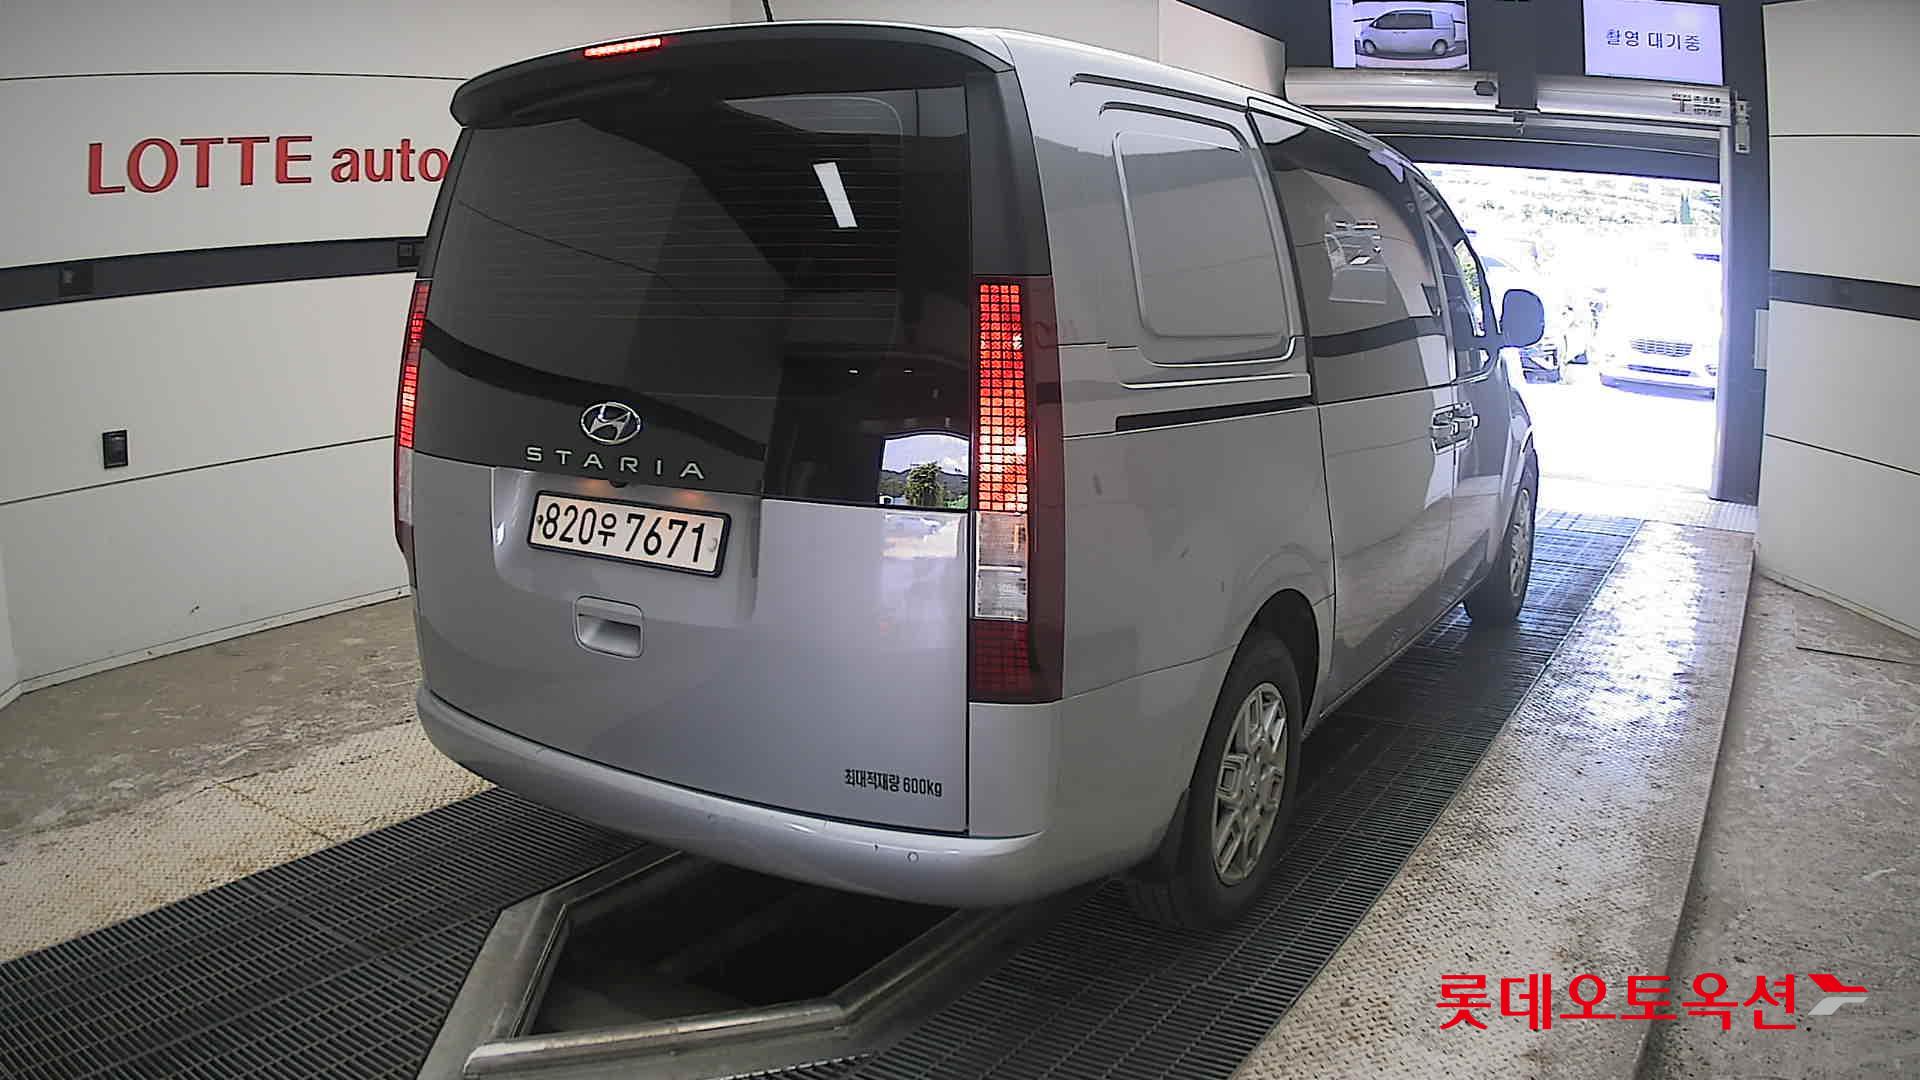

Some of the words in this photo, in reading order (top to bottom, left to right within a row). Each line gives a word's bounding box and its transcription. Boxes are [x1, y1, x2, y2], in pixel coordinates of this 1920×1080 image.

[1648, 32, 1701, 51] 대기중
[88, 135, 313, 195] LOTTE
[330, 138, 450, 183] auto
[526, 446, 705, 480] STARIA
[845, 769, 900, 792] 최대적재량
[903, 777, 942, 797] 600kg
